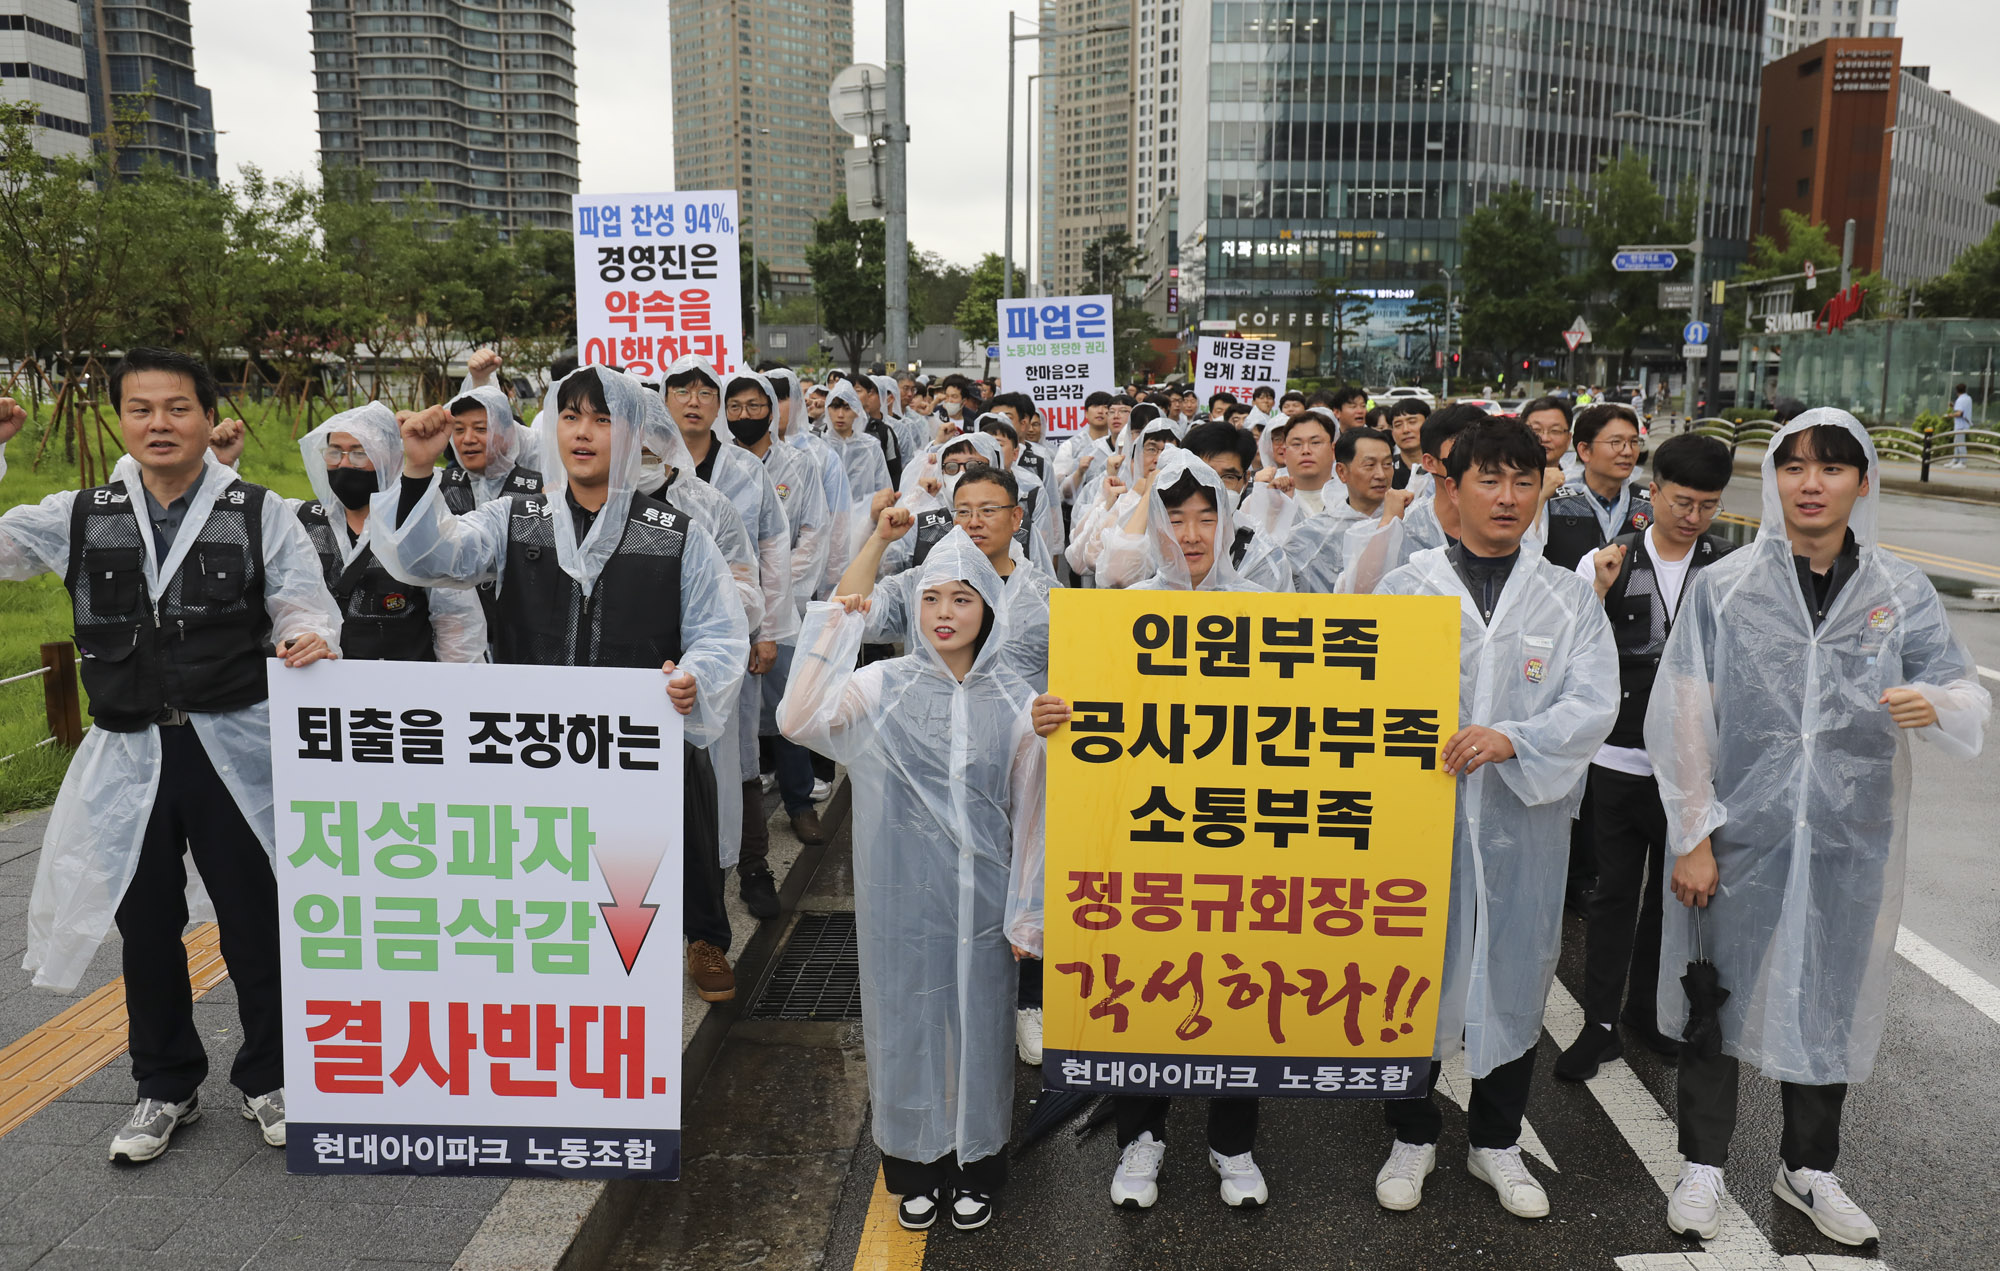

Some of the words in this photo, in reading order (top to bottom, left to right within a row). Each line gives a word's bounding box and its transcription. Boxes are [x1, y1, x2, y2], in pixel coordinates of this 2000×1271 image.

[579, 206, 622, 238] 파업
[631, 204, 675, 237] 찬성
[684, 203, 734, 235] 94%,
[598, 243, 718, 283] 경영진은
[1221, 240, 1252, 257] 치과
[605, 288, 711, 332] 약속을
[1006, 303, 1106, 341] 파업은
[1238, 312, 1331, 327] COFFEE
[1765, 310, 1814, 334] SUMMIT
[585, 334, 735, 377] 이행하라.
[1006, 344, 1047, 357] 노동자의
[1050, 342, 1082, 356] 정당한
[1213, 341, 1276, 361] 배당금은
[1025, 363, 1090, 381] 한마음으로
[1204, 361, 1235, 381] 업계
[1241, 364, 1281, 383] 최고...
[1033, 384, 1085, 401] 임금삭감
[514, 476, 537, 490] 투쟁
[643, 507, 677, 528] 투쟁
[1132, 613, 1380, 681] 인원부족
[298, 706, 444, 766] 퇴출을
[468, 710, 661, 771] 조장하는
[1070, 700, 1441, 770] 공사기간부족
[1130, 785, 1374, 850] 소통부족
[287, 800, 597, 882] 저성과자
[1066, 870, 1428, 938] 정몽규회장은
[292, 893, 597, 976] 임금삭감
[1055, 950, 1432, 1047] 각성하라!!
[304, 999, 667, 1100] 결사반대.
[1061, 1058, 1259, 1091] 현대아이파크
[1279, 1064, 1413, 1092] 노동조합
[312, 1132, 512, 1168] 현대아이파크
[524, 1137, 656, 1170] 노동조합
